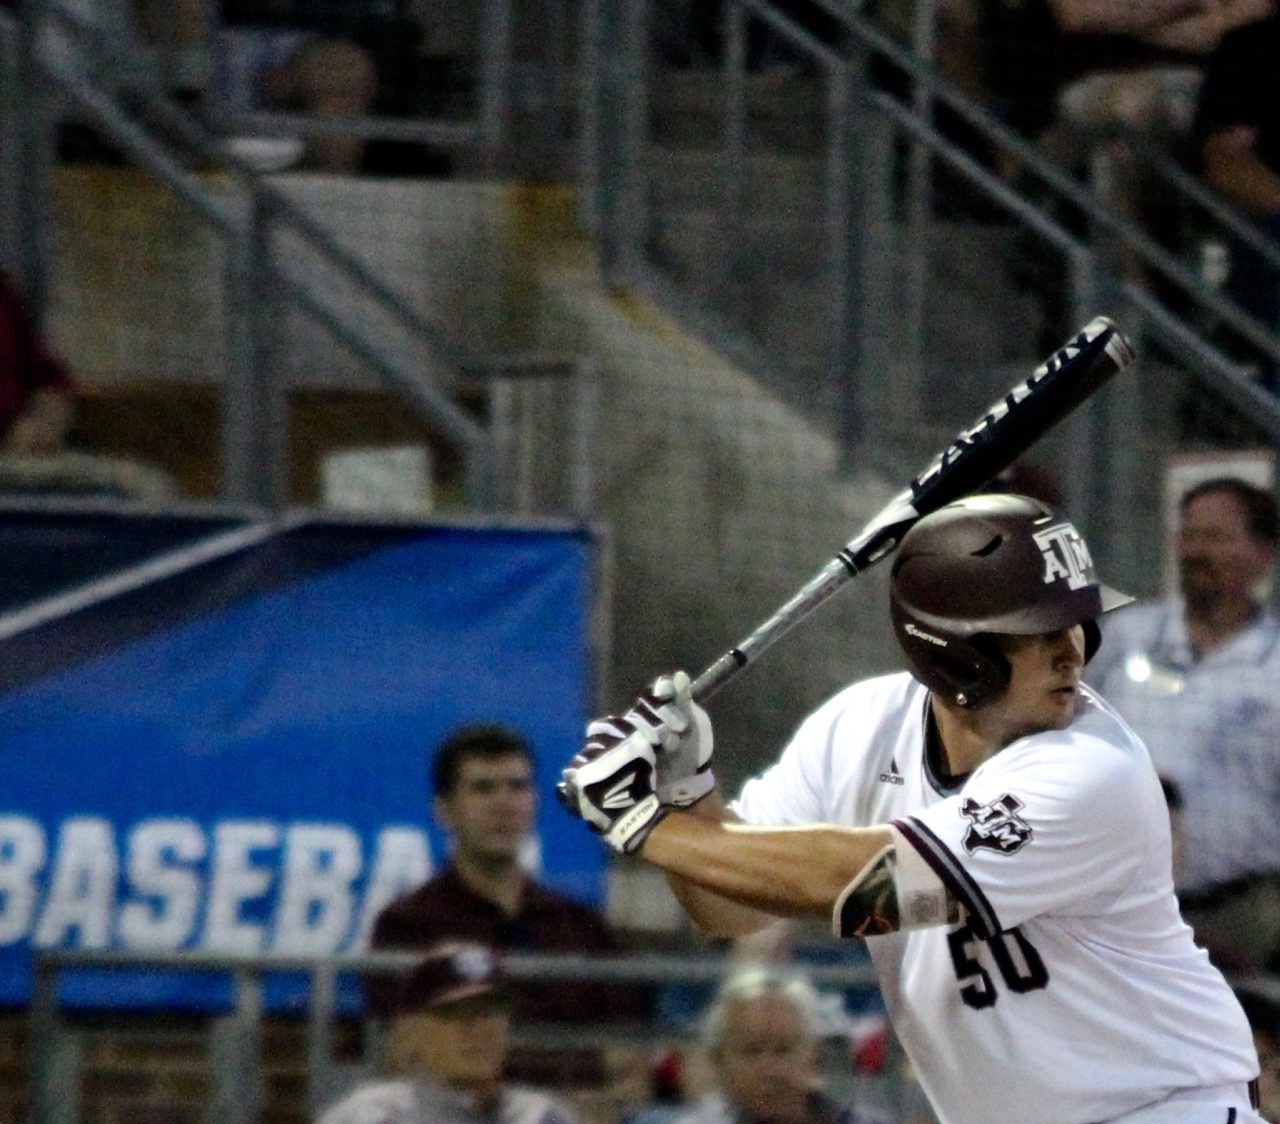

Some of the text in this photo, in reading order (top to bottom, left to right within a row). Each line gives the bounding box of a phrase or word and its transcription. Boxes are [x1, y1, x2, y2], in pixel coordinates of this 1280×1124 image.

[912, 627, 949, 648] EASTON
[878, 772, 906, 787] aas
[618, 800, 656, 836] EASTON
[0, 812, 541, 957] BASEBA
[946, 926, 1050, 1011] 50
